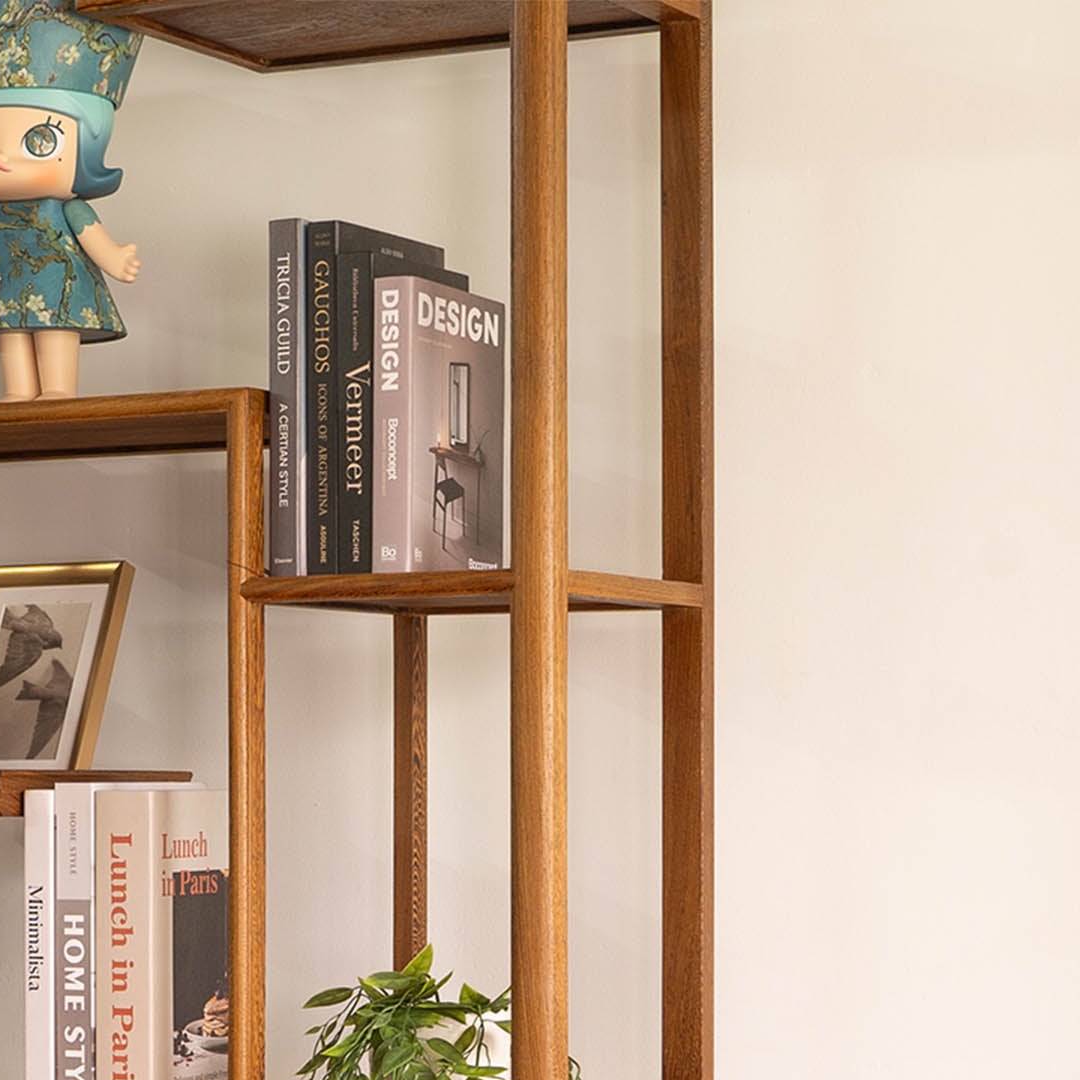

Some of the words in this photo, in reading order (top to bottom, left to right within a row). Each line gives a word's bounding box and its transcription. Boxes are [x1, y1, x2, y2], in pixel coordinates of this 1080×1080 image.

[277, 252, 291, 315] TRICIA
[314, 260, 330, 373] GAUCHOS
[381, 289, 399, 392] DESIGN
[417, 292, 499, 347] DESIGN
[277, 318, 291, 374] GUILD
[279, 402, 288, 412] A
[318, 383, 328, 421] ICONS
[345, 361, 371, 495] Vermeer
[318, 425, 328, 442] OF
[279, 470, 289, 507] STYLE
[318, 446, 328, 516] ARGENTINA
[352, 519, 360, 562] TASCHEN
[161, 831, 208, 859] Lunch
[110, 833, 134, 948] Lunch
[162, 869, 176, 897] in
[179, 867, 219, 897] Paris
[27, 885, 44, 992] Minimalista
[63, 914, 85, 1012] HOME
[111, 959, 135, 994] in
